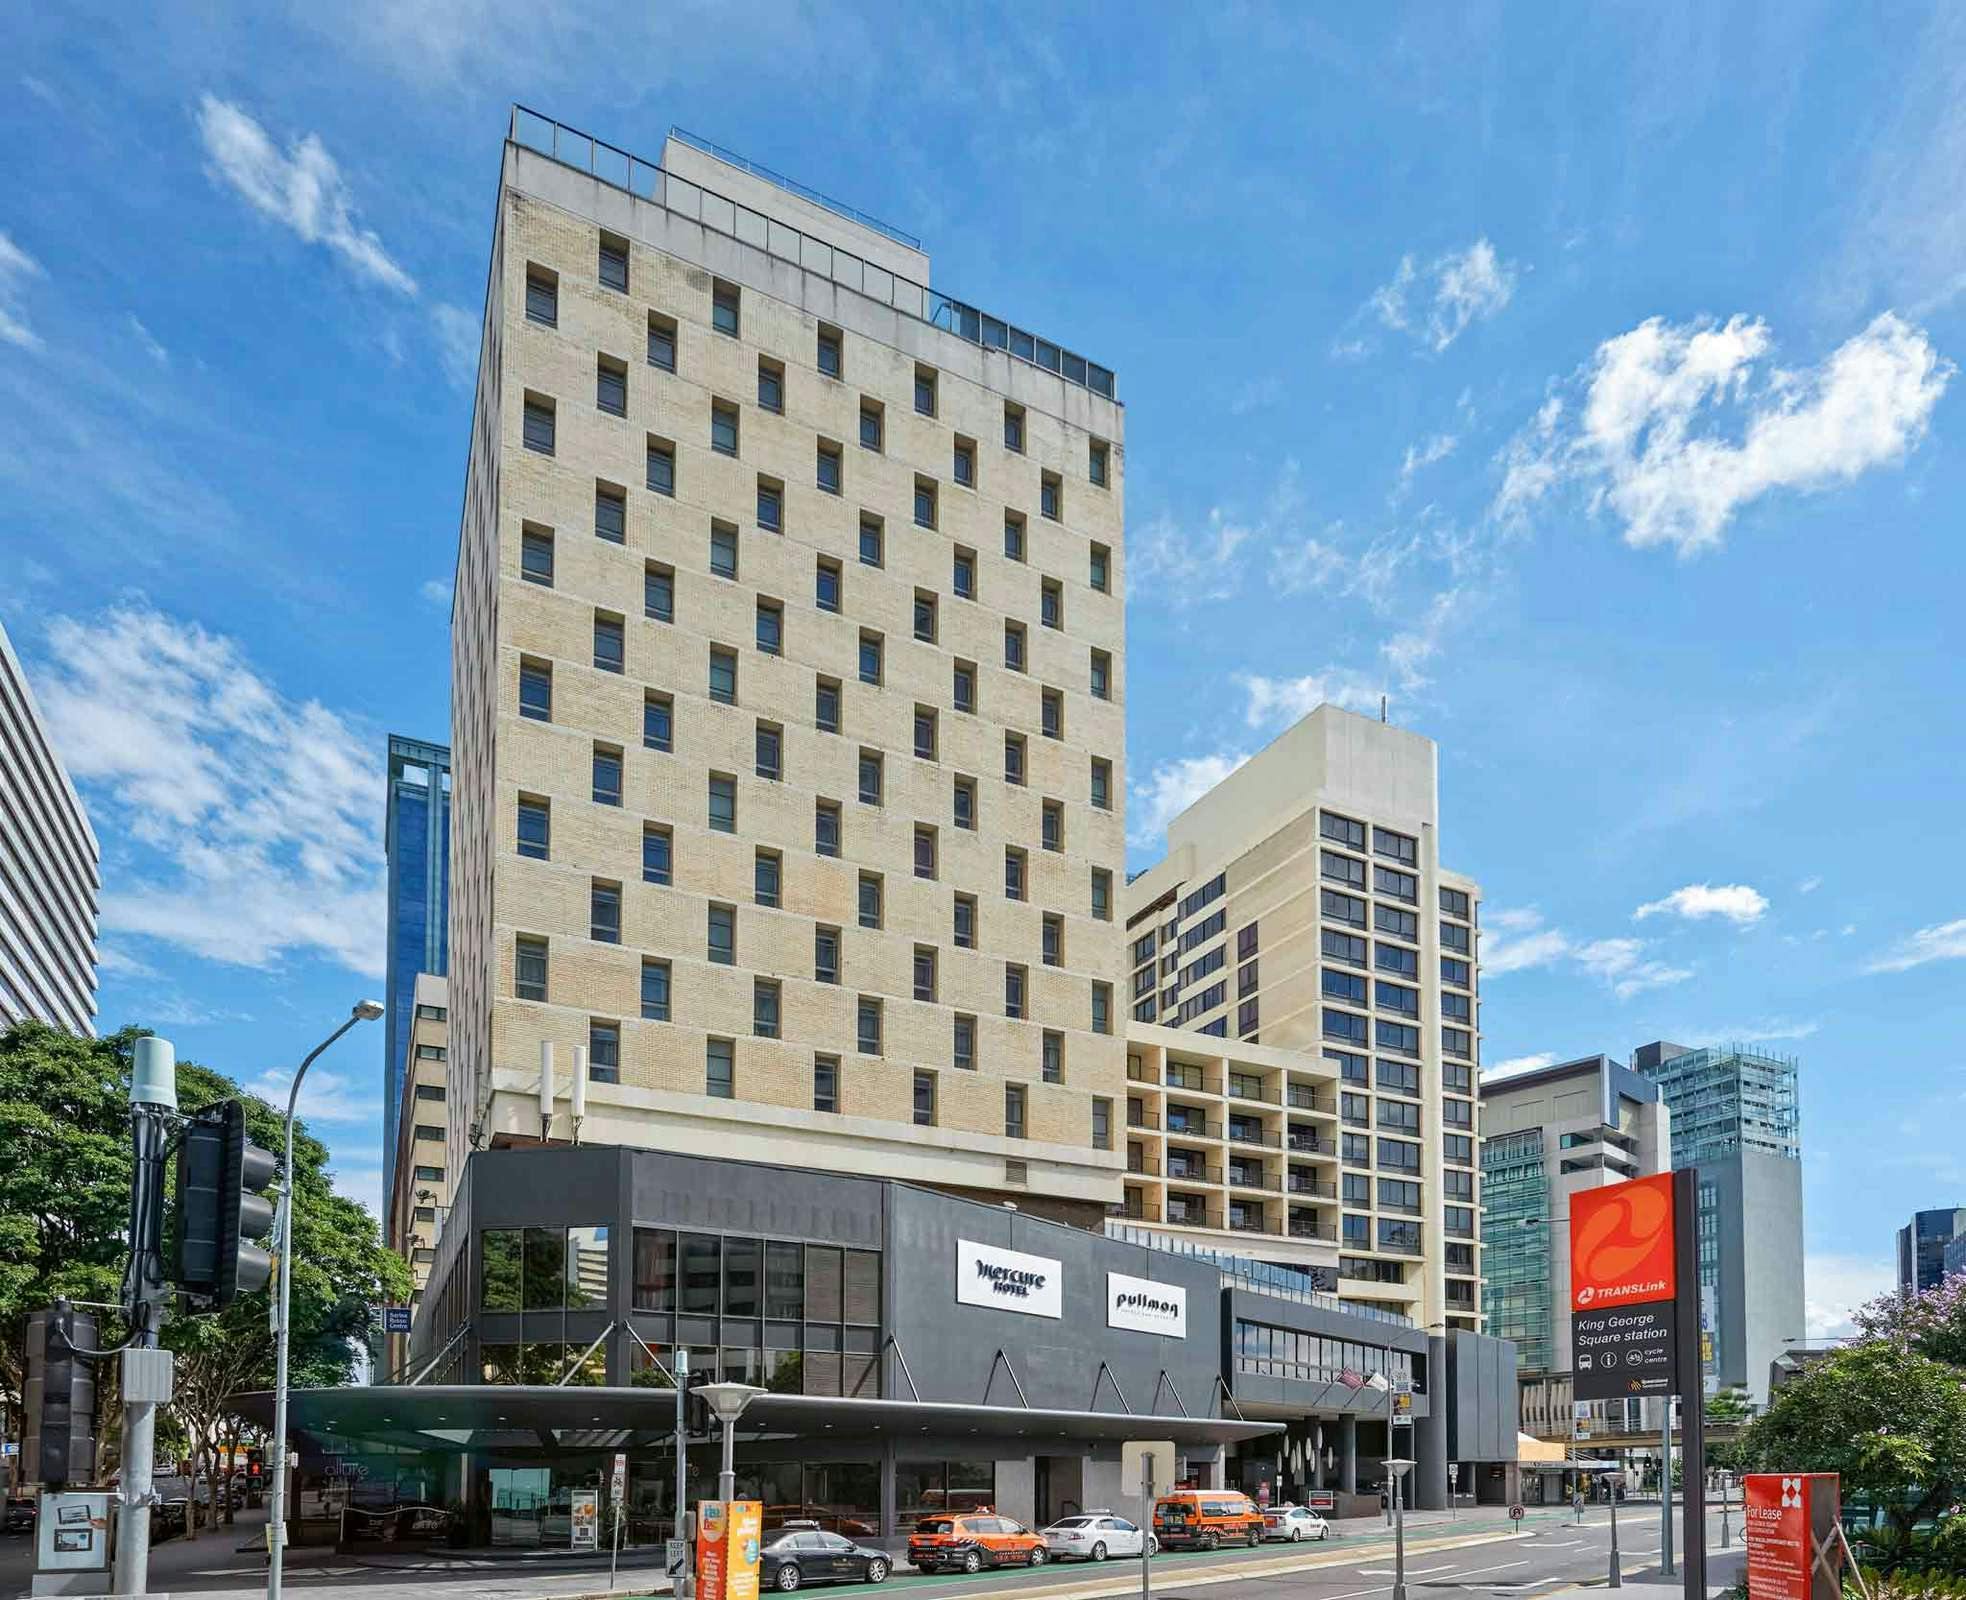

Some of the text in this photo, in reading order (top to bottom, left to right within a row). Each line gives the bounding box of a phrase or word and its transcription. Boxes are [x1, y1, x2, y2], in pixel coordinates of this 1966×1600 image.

[993, 1280, 1030, 1297] HOTEL
[1598, 1280, 1667, 1298] TRANSLink
[1578, 1314, 1654, 1332] King George
[1578, 1328, 1668, 1347] Square station
[1644, 1347, 1664, 1356] cycle
[1644, 1356, 1668, 1365] centre
[1746, 1504, 1782, 1521] For Lease
